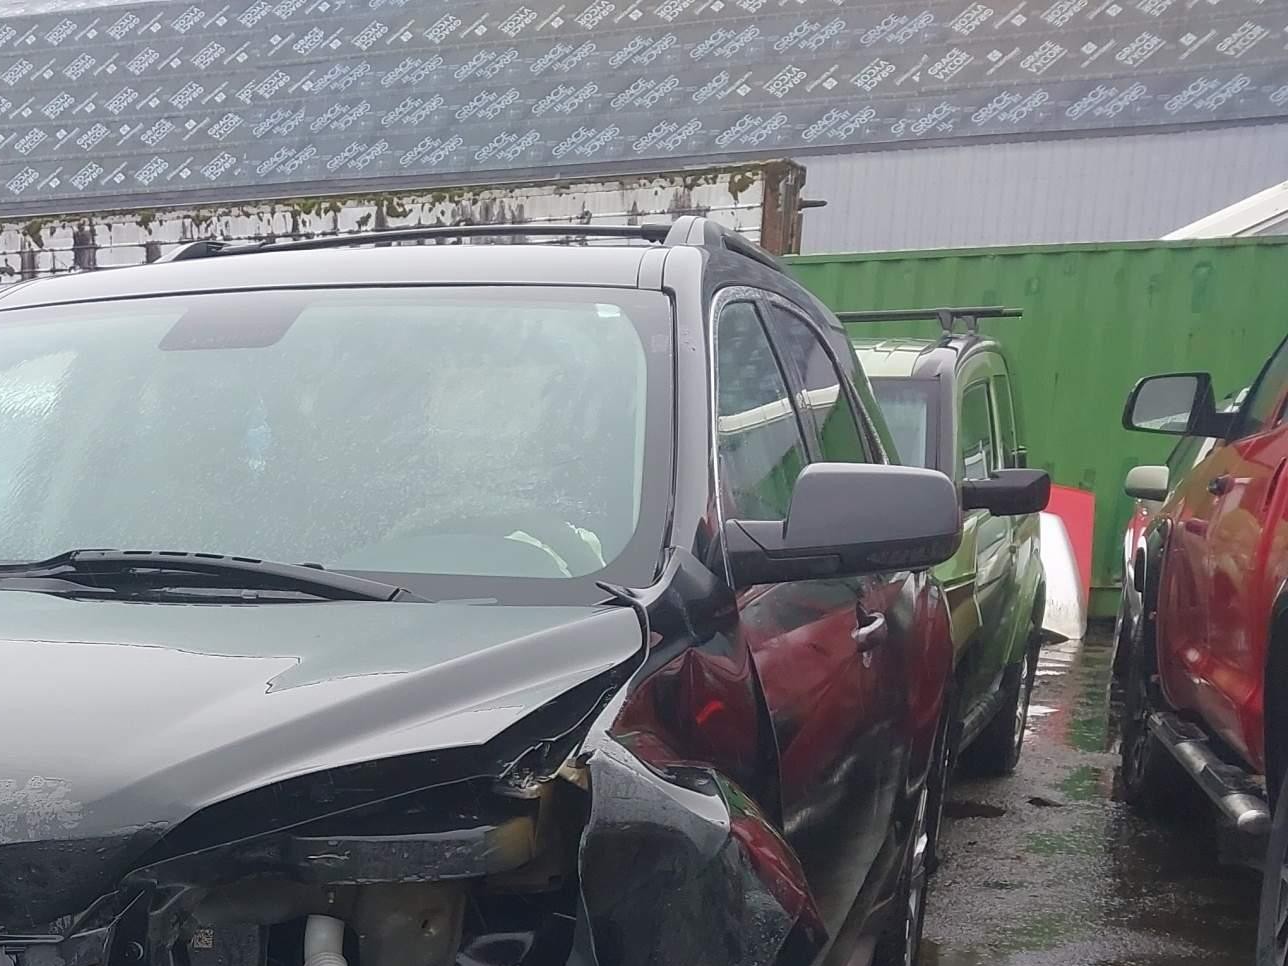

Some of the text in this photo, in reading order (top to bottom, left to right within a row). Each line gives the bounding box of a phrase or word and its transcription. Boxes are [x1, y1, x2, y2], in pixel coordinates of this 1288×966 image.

[502, 9, 531, 34] VYCOR
[508, 13, 537, 37] GRACE
[579, 2, 610, 27] VYCOR
[586, 6, 616, 30] GRACE
[860, 12, 898, 45] GRACE
[897, 11, 934, 44] GRACE
[953, 4, 987, 32] VYCOR
[961, 9, 994, 36] GRACE
[641, 33, 677, 65] GRACE
[690, 28, 725, 59] GRACE
[724, 25, 760, 57] GRACE
[774, 20, 810, 51] GRACE
[810, 18, 846, 49] GRACE
[1116, 31, 1153, 60] GRACE
[1216, 21, 1256, 51] GRACE
[1224, 26, 1265, 56] VYCOR
[454, 50, 489, 80] GRACE
[485, 49, 519, 79] GRACE
[530, 43, 563, 73] GRACE
[562, 41, 596, 72] GRACE
[609, 35, 644, 67] GRACE
[928, 48, 963, 75] GRACE
[935, 52, 970, 80] VYCOR
[1020, 40, 1056, 68] GRACE
[1027, 44, 1063, 73] VYCOR
[1123, 36, 1161, 65] VYCOR
[693, 71, 729, 101] GRACE
[767, 68, 801, 94] VYCOR
[774, 72, 807, 98] GRACE
[855, 61, 890, 88] VYCOR
[862, 65, 896, 91] GRACE
[456, 91, 489, 120] GRACE
[486, 88, 520, 120] GRACE
[532, 84, 564, 114] GRACE
[564, 82, 598, 114] GRACE
[611, 78, 647, 109] GRACE
[644, 75, 679, 108] GRACE
[972, 91, 1011, 123] GRACE
[1011, 89, 1049, 123] GRACE
[1066, 85, 1108, 118] GRACE
[1107, 83, 1147, 117] GRACE
[1165, 77, 1209, 112] GRACE
[1208, 74, 1250, 111] GRACE
[716, 114, 753, 145] GRACE
[749, 112, 788, 145] GRACE
[802, 108, 841, 141] GRACE
[837, 107, 876, 139] GRACE
[911, 101, 951, 134] GRACE
[475, 132, 509, 162] GRACE
[506, 129, 540, 161] GRACE
[552, 127, 587, 157] GRACE
[584, 124, 620, 157] GRACE
[633, 121, 668, 152] GRACE
[665, 118, 702, 150] GRACE
